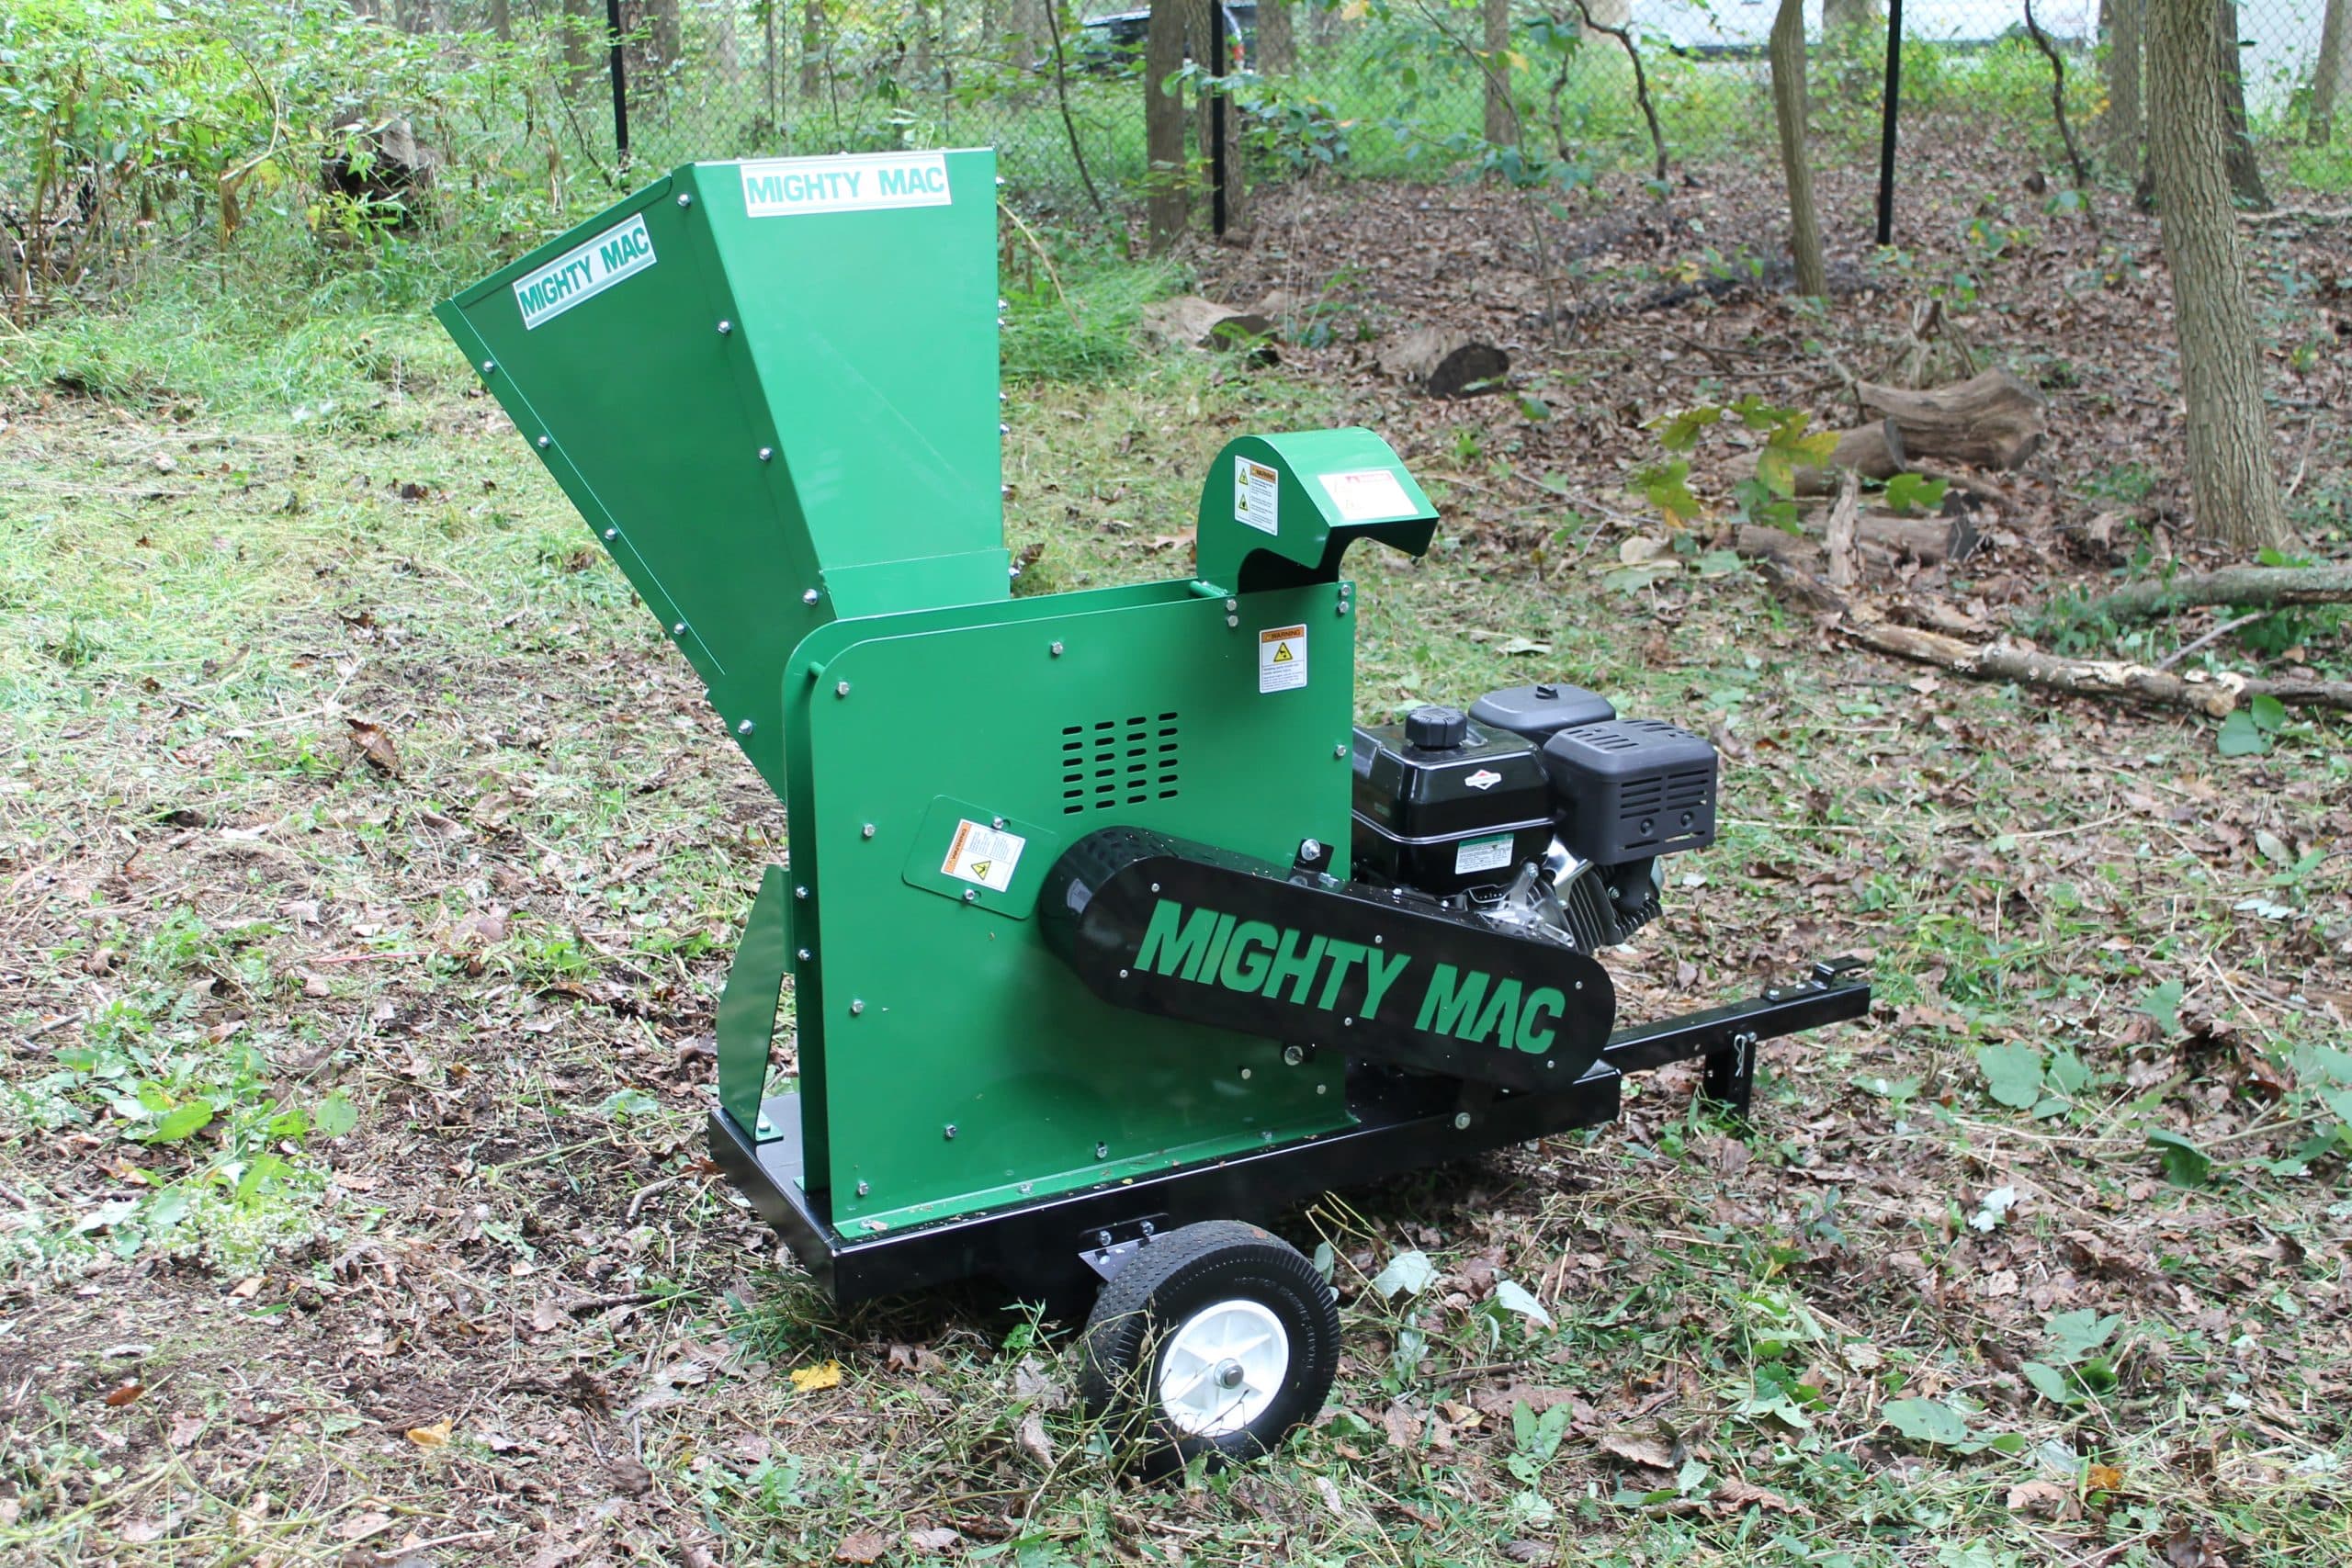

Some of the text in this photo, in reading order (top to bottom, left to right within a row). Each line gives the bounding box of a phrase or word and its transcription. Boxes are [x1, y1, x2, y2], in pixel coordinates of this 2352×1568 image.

[746, 166, 944, 204] MIGHTY MAC
[518, 227, 650, 318] MIGHTY MAC
[1134, 899, 1566, 1055] MIGHTY MAC
